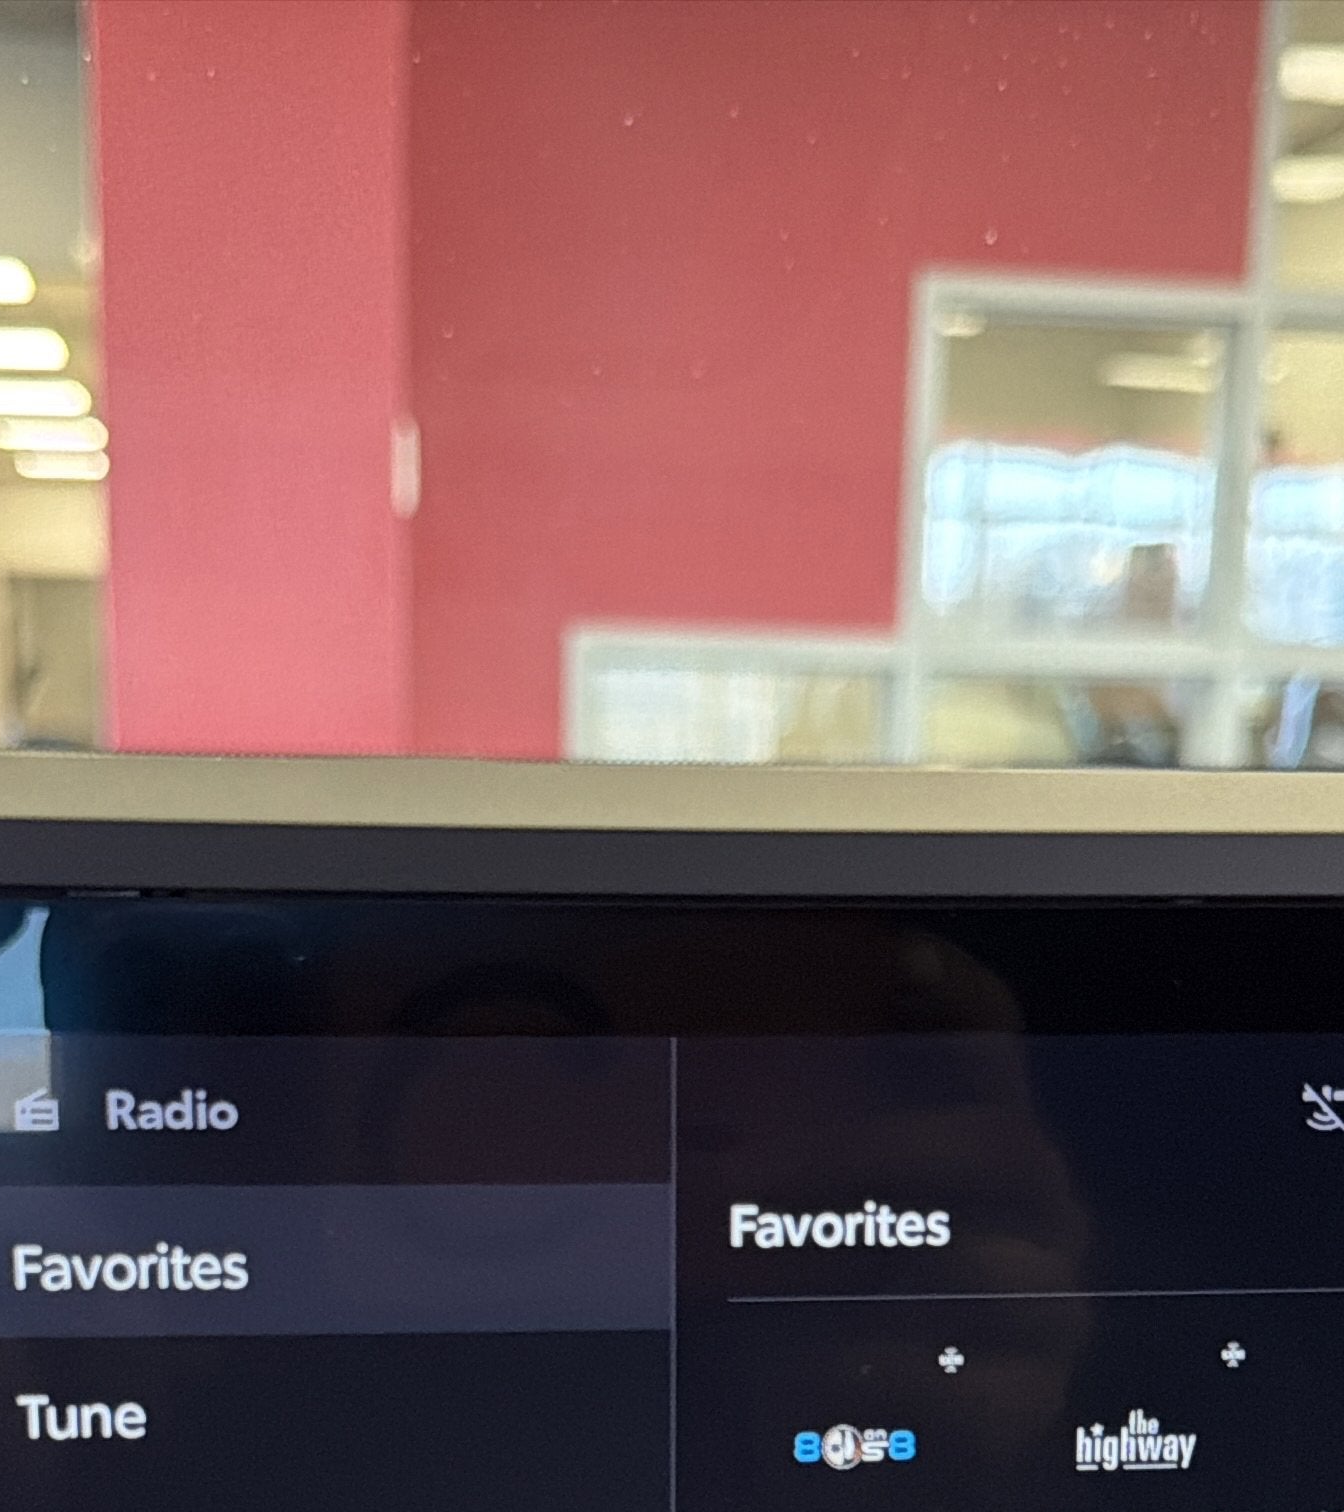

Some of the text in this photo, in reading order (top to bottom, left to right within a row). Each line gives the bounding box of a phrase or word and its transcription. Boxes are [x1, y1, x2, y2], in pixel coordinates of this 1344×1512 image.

[104, 1089, 240, 1131] Radio
[729, 1200, 952, 1249] Favorites
[12, 1242, 250, 1292] Favorites
[15, 1394, 148, 1441] Tune
[1128, 1407, 1160, 1436] the
[1075, 1422, 1198, 1472] highway
